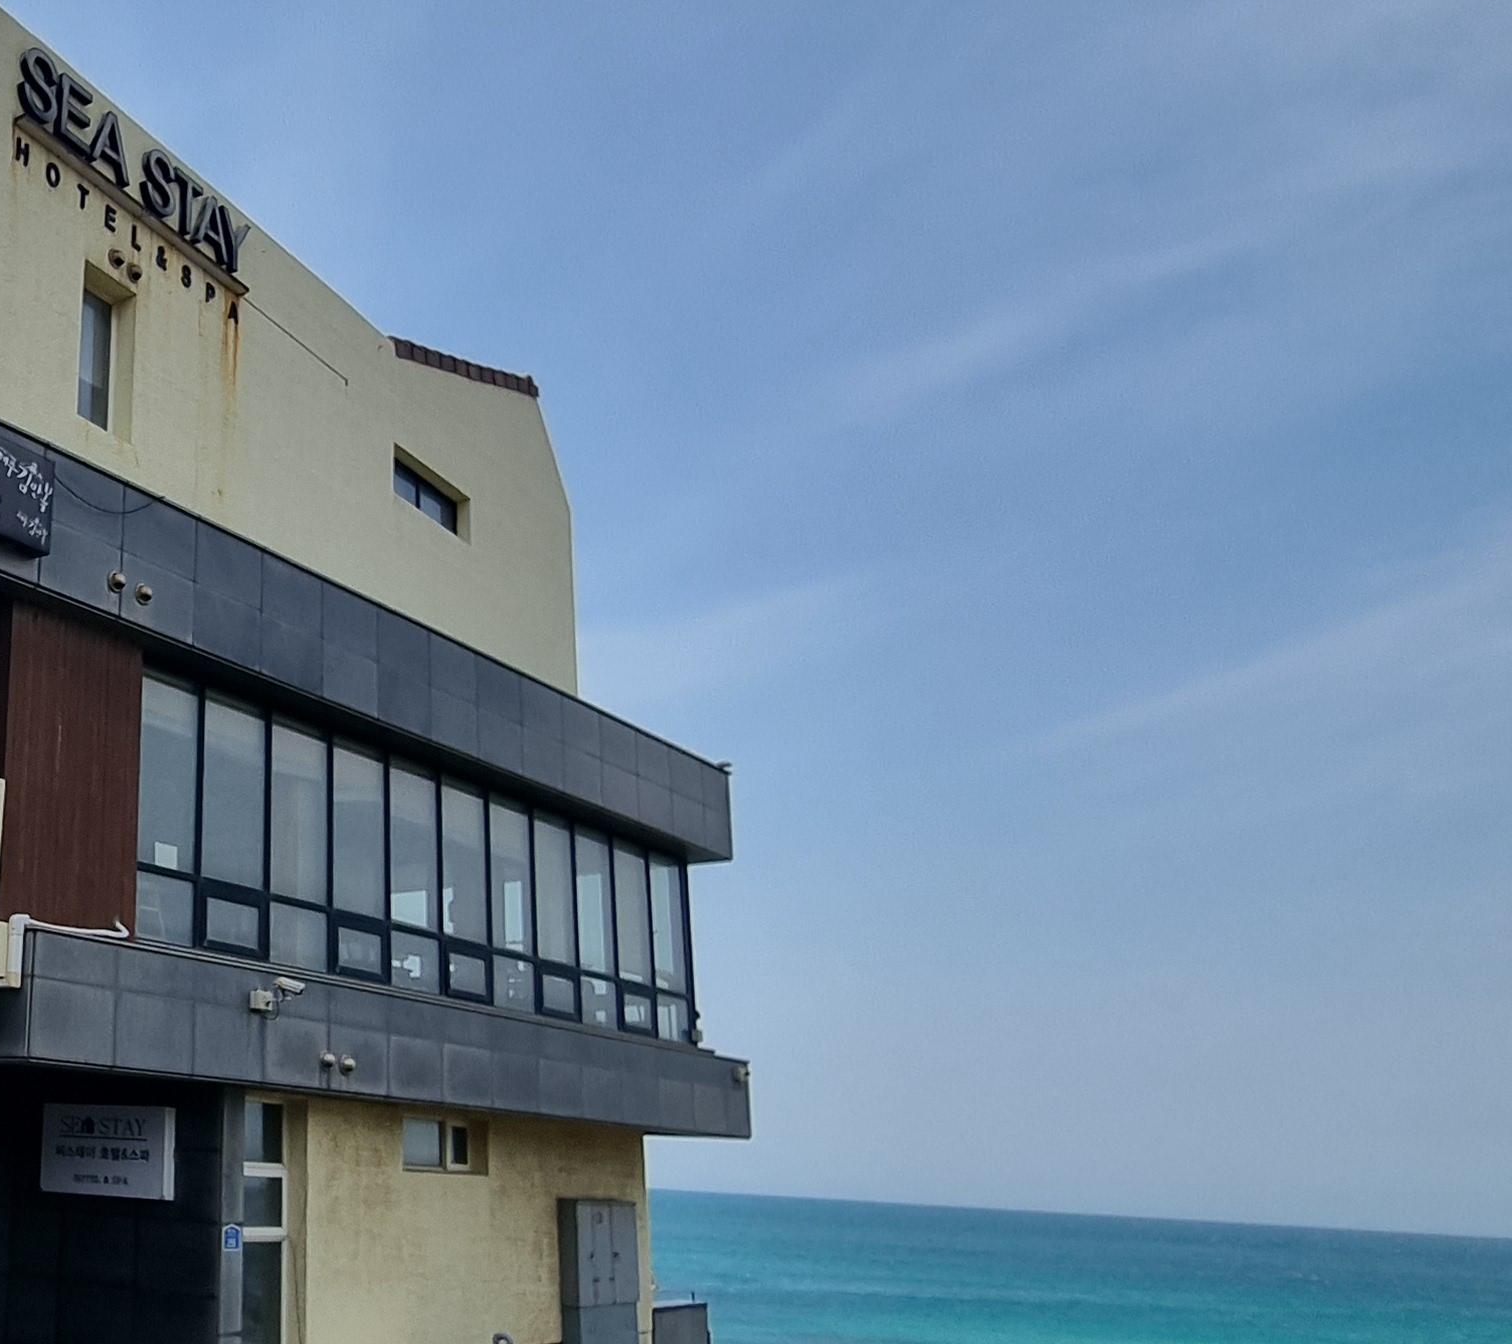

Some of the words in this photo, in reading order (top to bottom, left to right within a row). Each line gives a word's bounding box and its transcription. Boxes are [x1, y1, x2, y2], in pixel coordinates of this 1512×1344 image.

[15, 136, 142, 252] HOTEL
[180, 264, 240, 327] SPA
[16, 46, 130, 189] SEA
[139, 148, 251, 274] STAY
[99, 1117, 147, 1137] STAY
